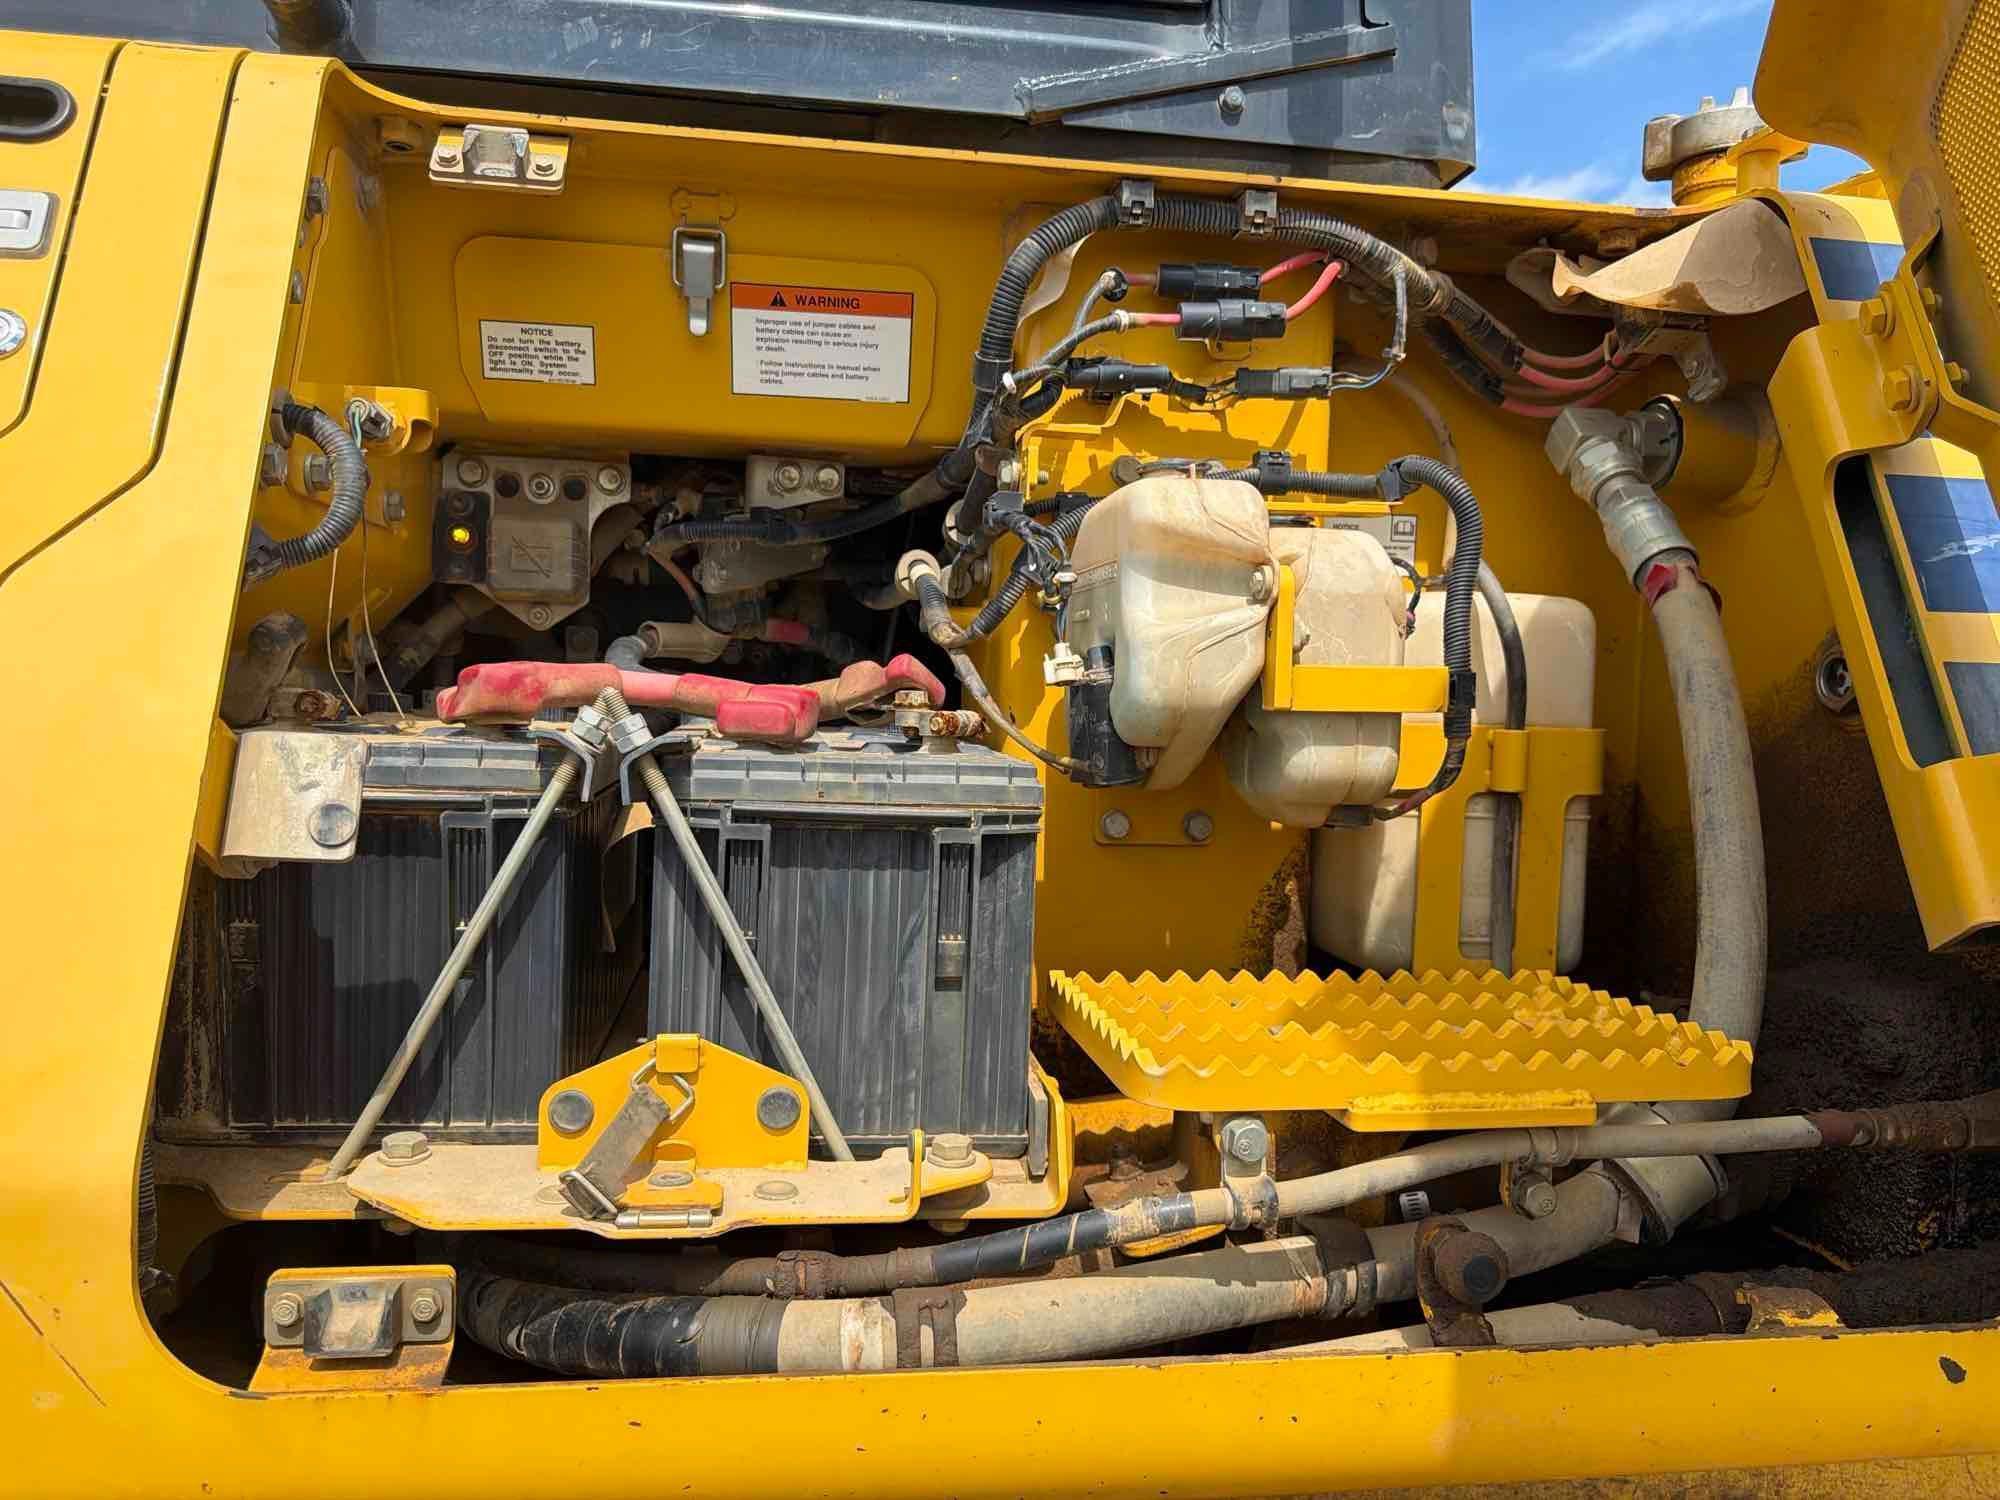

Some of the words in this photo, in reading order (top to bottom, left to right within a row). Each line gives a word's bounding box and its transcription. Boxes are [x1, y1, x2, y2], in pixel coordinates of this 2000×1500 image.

[795, 294, 860, 309] WARNING
[756, 318, 787, 327] Improper
[812, 320, 837, 329] jumper
[838, 322, 861, 330] cables
[521, 327, 553, 336] NOTICE
[755, 327, 780, 336] battery
[781, 328, 805, 336] cables
[555, 340, 581, 349] battery
[755, 336, 790, 345] explosion
[791, 338, 823, 347] resulting
[859, 340, 880, 350] injury
[488, 344, 529, 352] disconnect
[534, 345, 558, 353] switch
[765, 344, 786, 352] death.
[508, 352, 539, 360] position
[489, 359, 506, 367] light
[540, 361, 567, 369] System
[784, 361, 826, 370] instructions
[759, 369, 780, 378] using
[781, 370, 806, 379] jumper
[807, 371, 830, 379] cables
[831, 372, 845, 380] and
[845, 373, 869, 382] battery
